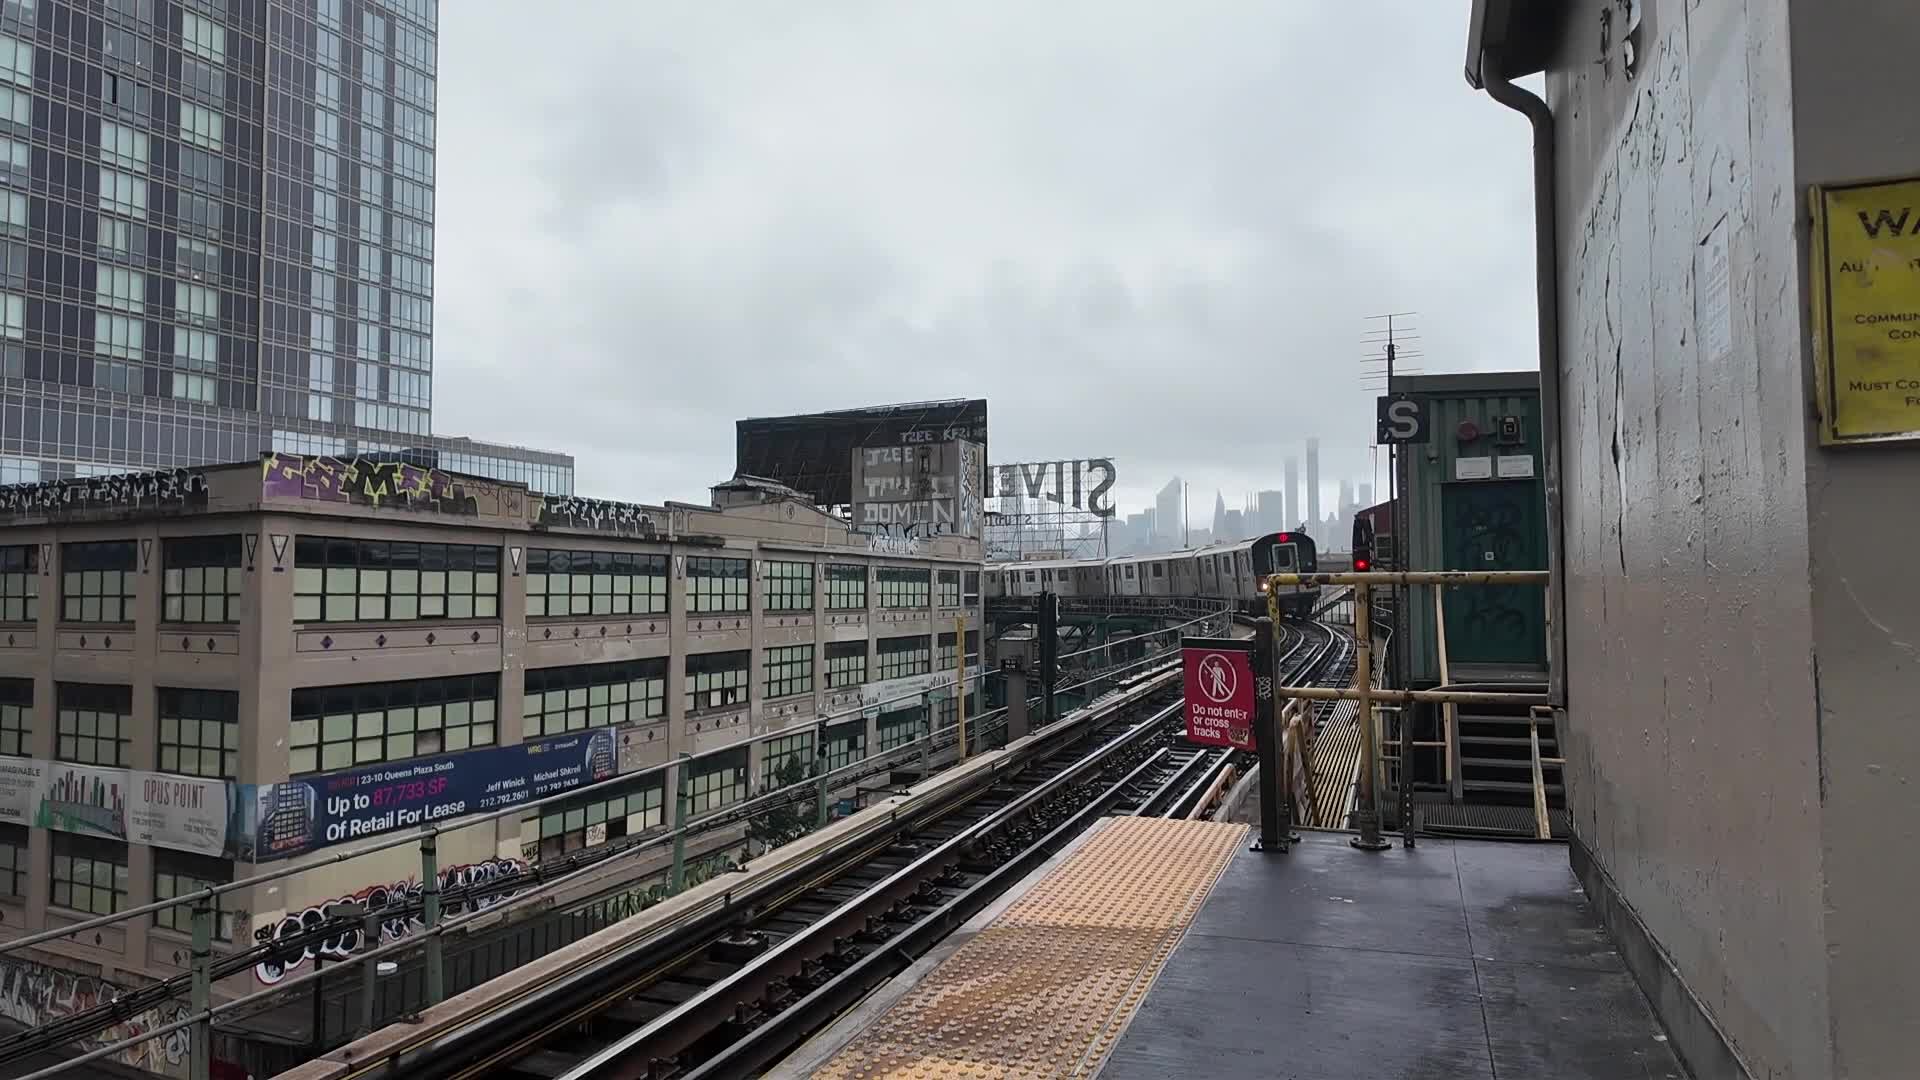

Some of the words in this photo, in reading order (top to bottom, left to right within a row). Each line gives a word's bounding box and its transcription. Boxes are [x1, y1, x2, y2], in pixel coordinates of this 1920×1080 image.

[1388, 400, 1418, 439] S
[1192, 703, 1206, 715] Do
[1207, 706, 1223, 716] not
[1193, 716, 1203, 725] or
[1204, 718, 1230, 728] cross
[1193, 726, 1221, 738] tracks
[384, 769, 411, 781] Queens
[413, 765, 432, 775] Plaza
[434, 761, 454, 771] South
[144, 779, 170, 806] OPUS
[173, 782, 206, 809] POINT
[429, 777, 448, 794] SF
[485, 783, 501, 793] Jeff
[502, 777, 526, 790] Winick
[327, 796, 350, 816] Up
[353, 793, 370, 809] to
[326, 823, 348, 841] Of
[350, 813, 394, 835] Retail
[397, 809, 422, 825] For
[424, 798, 465, 819] Lease
